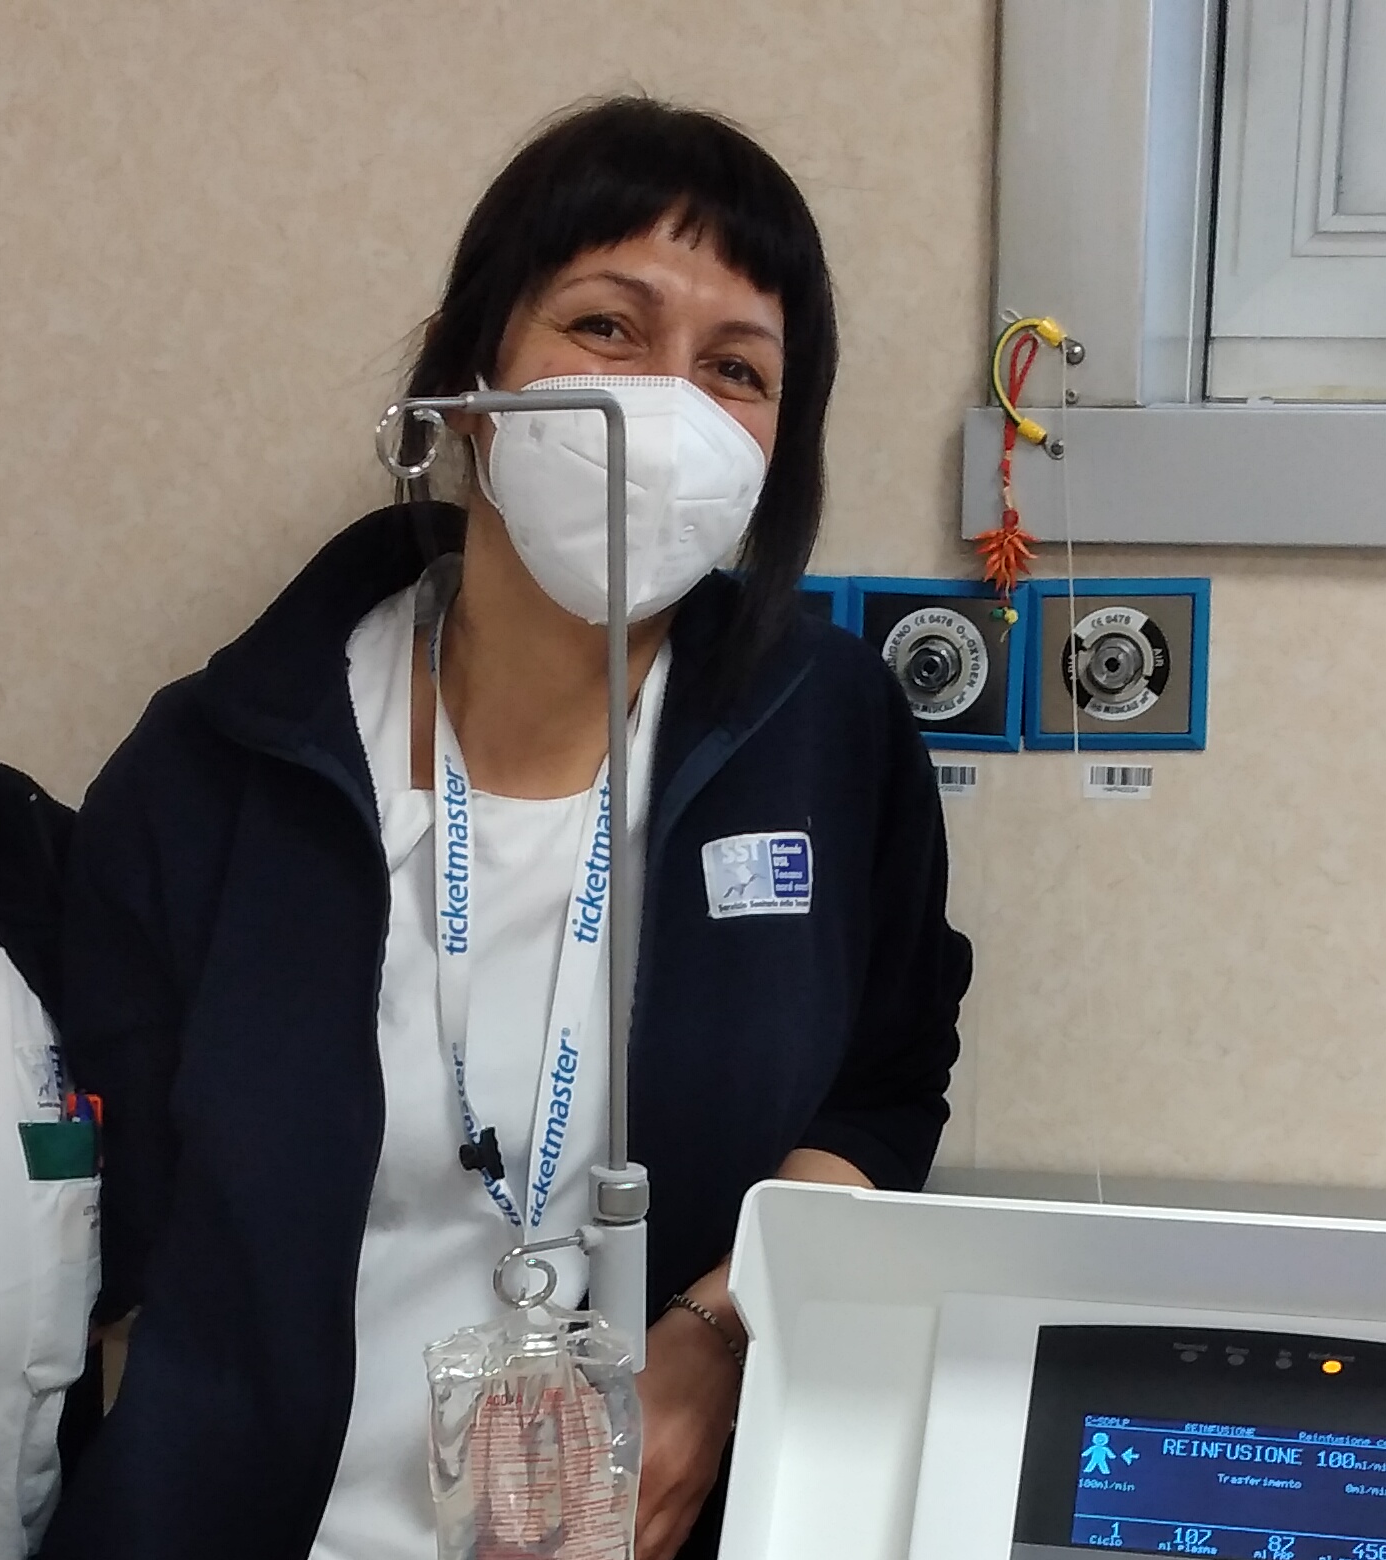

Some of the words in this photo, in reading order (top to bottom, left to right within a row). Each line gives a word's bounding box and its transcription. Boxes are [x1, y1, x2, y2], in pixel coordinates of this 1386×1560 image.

[440, 764, 469, 956] ticketmaster
[529, 1038, 579, 1228] ticketmaster
[1163, 1438, 1304, 1466] REINFUSIONE
[1217, 1473, 1303, 1490] Trasferimento
[1111, 1521, 1121, 1538] 1
[1173, 1527, 1212, 1546] 107
[1089, 1534, 1123, 1547] Ciclo
[1268, 1535, 1295, 1552] 87
